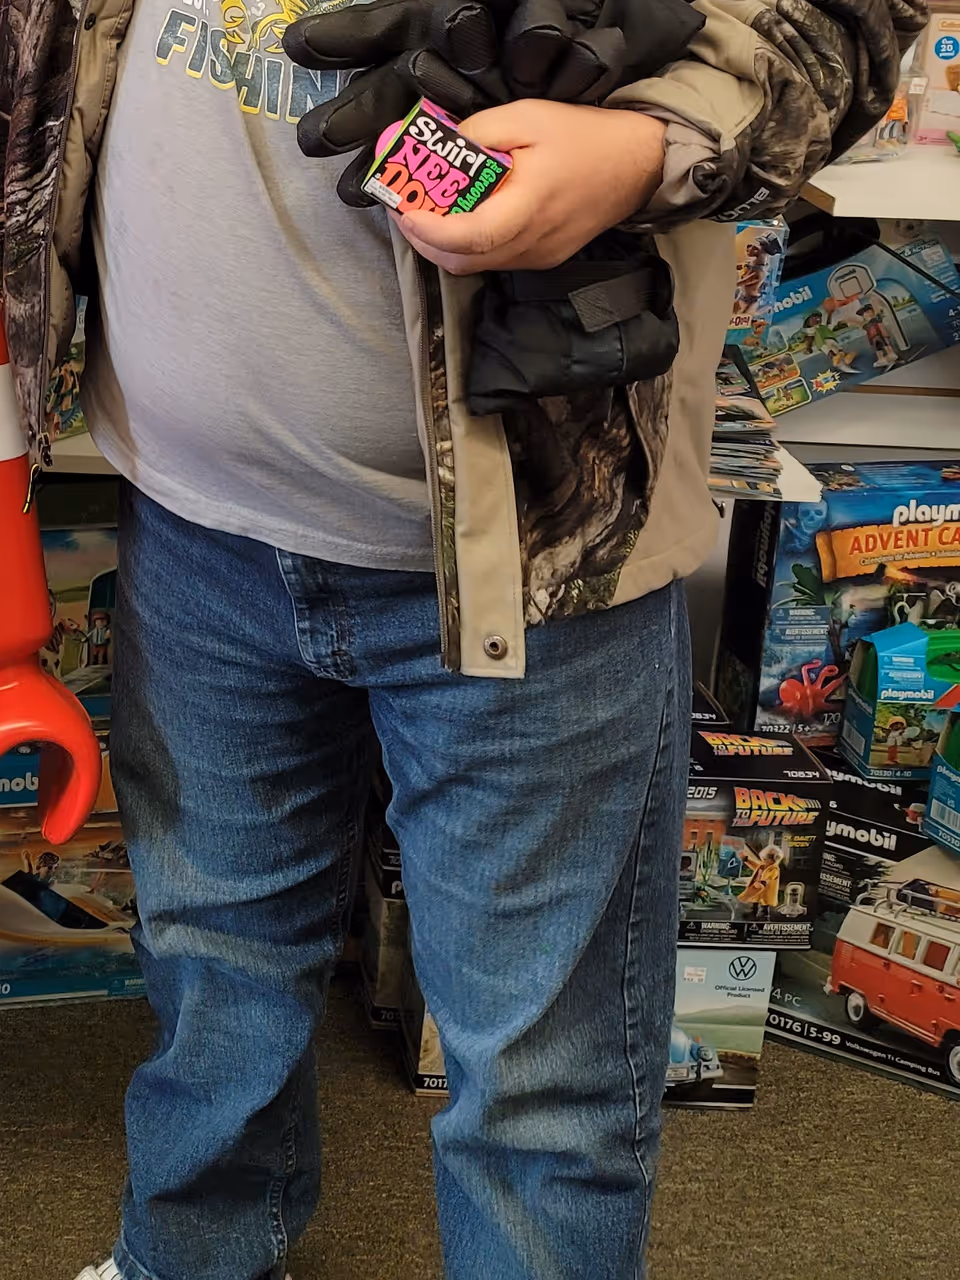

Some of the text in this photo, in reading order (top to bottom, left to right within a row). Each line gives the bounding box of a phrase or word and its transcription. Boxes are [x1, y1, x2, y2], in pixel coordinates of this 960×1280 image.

[159, 7, 362, 124] FISHIN
[408, 116, 487, 177] Swirl
[849, 528, 933, 556] ADVENT
[881, 688, 935, 701] playmobil
[696, 731, 778, 747] BACK
[728, 746, 793, 756] FUTURE
[687, 786, 718, 799] 2015
[734, 786, 808, 811] BACK
[735, 809, 750, 819] TO
[752, 811, 819, 826] FUTURE
[738, 985, 765, 993] Licensed
[771, 987, 802, 1008] 4 PC
[809, 1027, 841, 1045] 5-99
[845, 1041, 886, 1058] Volkswagen
[895, 1057, 927, 1072] Camping
[927, 1067, 940, 1076] Bus
